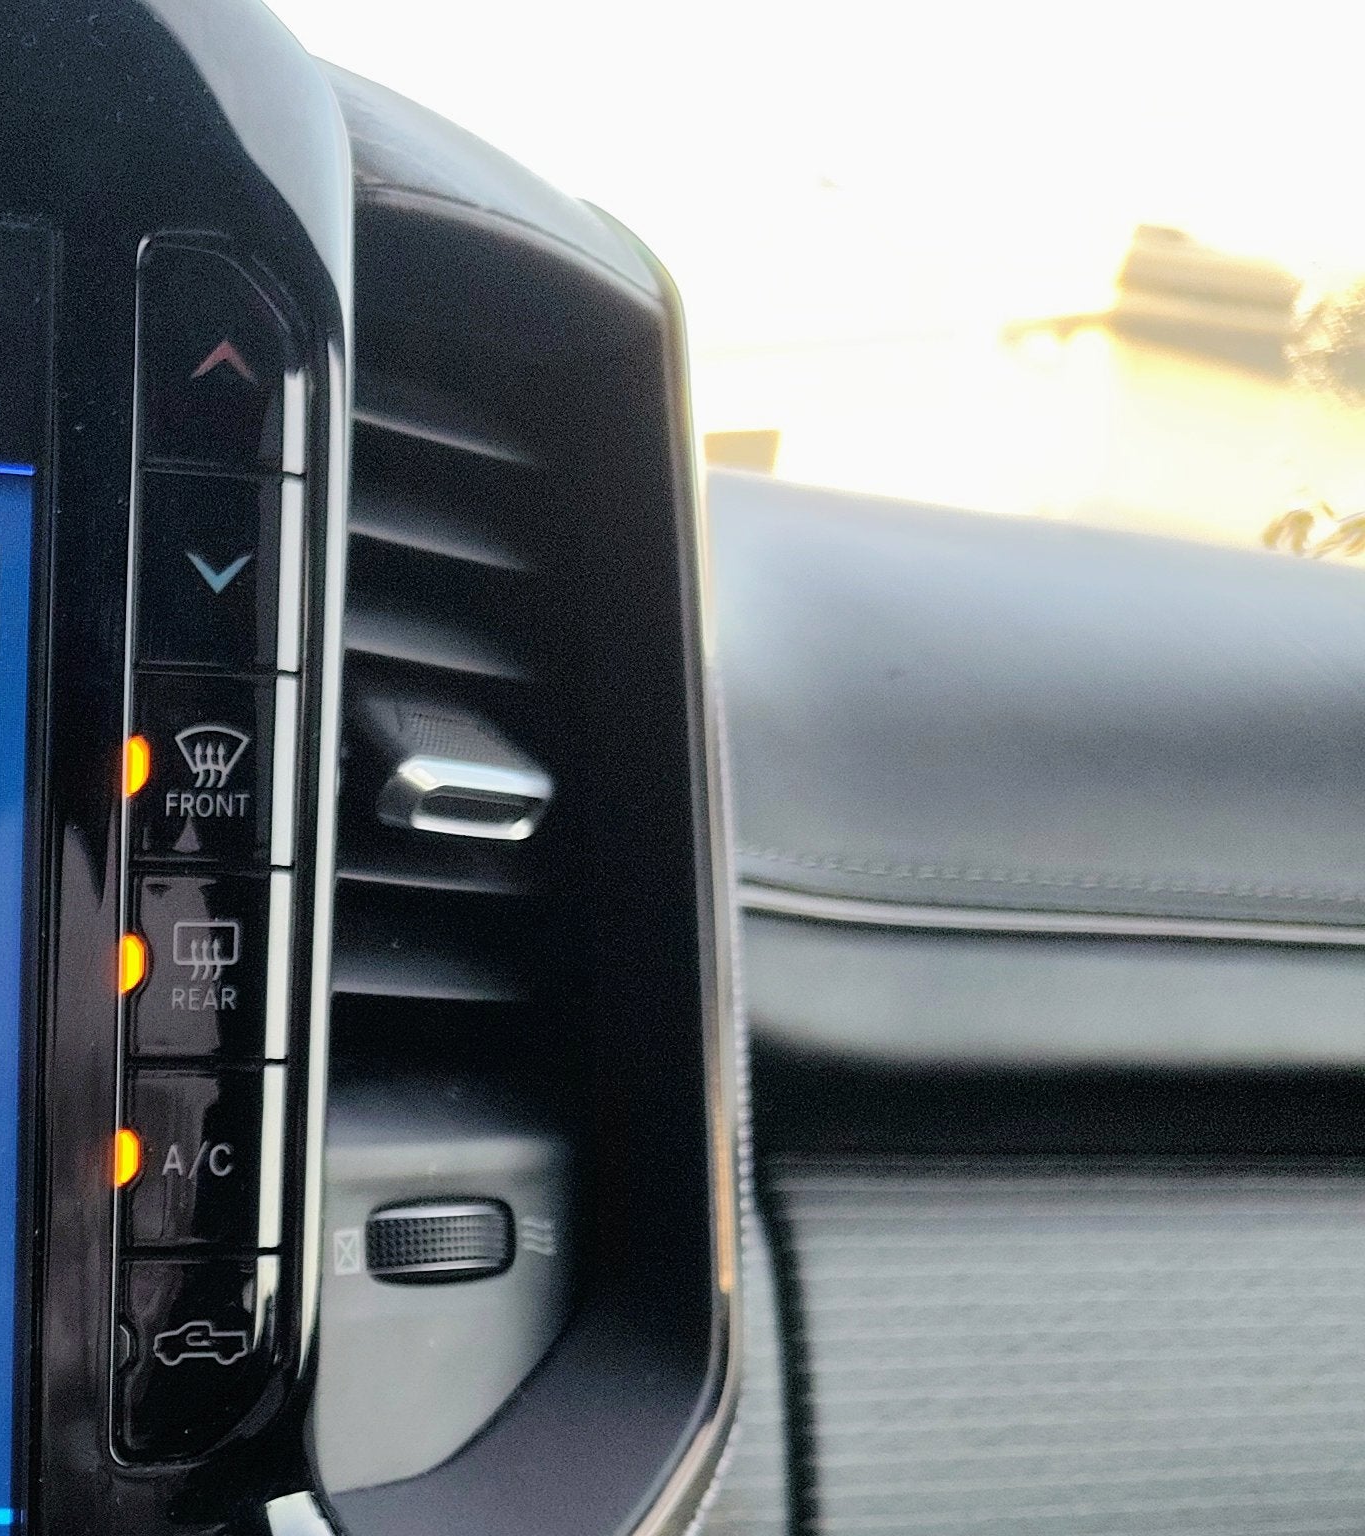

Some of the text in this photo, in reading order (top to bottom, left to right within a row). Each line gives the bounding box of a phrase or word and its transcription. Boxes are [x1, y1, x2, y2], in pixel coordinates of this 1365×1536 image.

[165, 794, 250, 818] FRONT
[170, 988, 237, 1010] REAR
[162, 1142, 234, 1178] A/C
